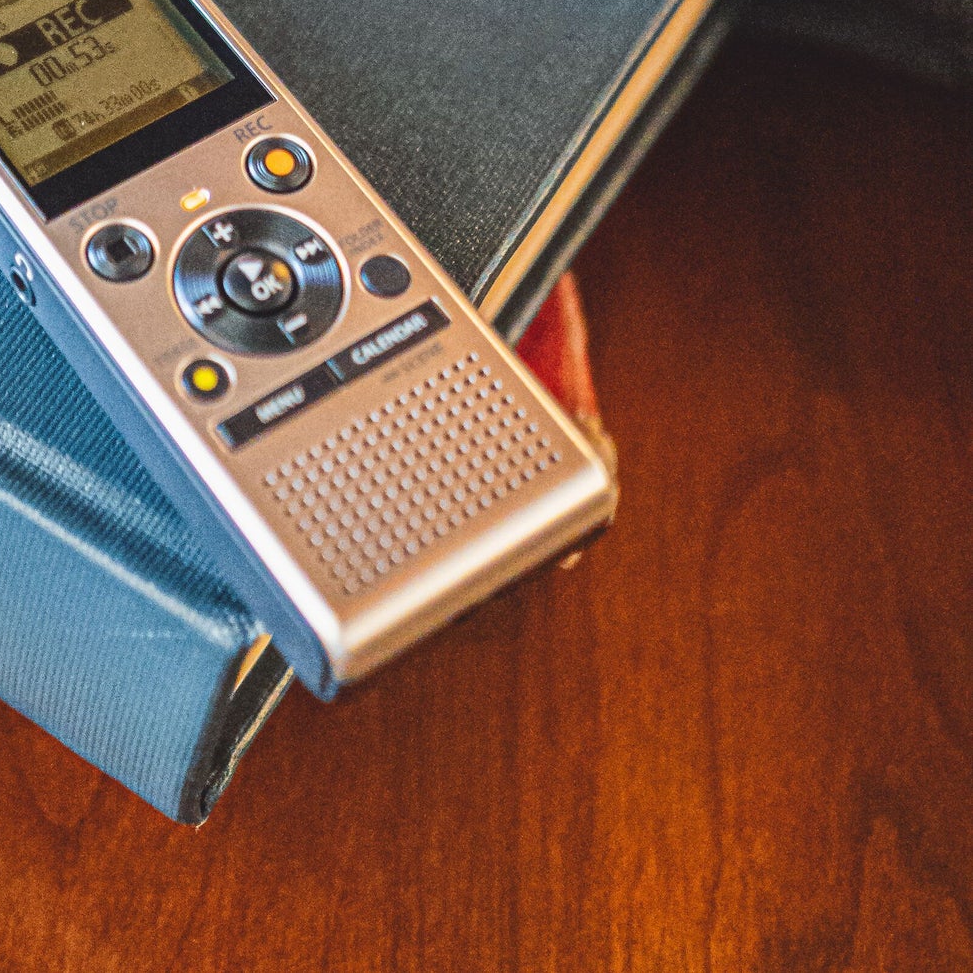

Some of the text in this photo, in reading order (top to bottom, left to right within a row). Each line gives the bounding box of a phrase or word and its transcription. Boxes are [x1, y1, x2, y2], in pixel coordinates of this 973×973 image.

[34, 0, 104, 48] REC
[232, 115, 274, 144] REC
[67, 198, 120, 233] STOP
[249, 276, 282, 302] OK
[351, 312, 429, 365] CALENDAR
